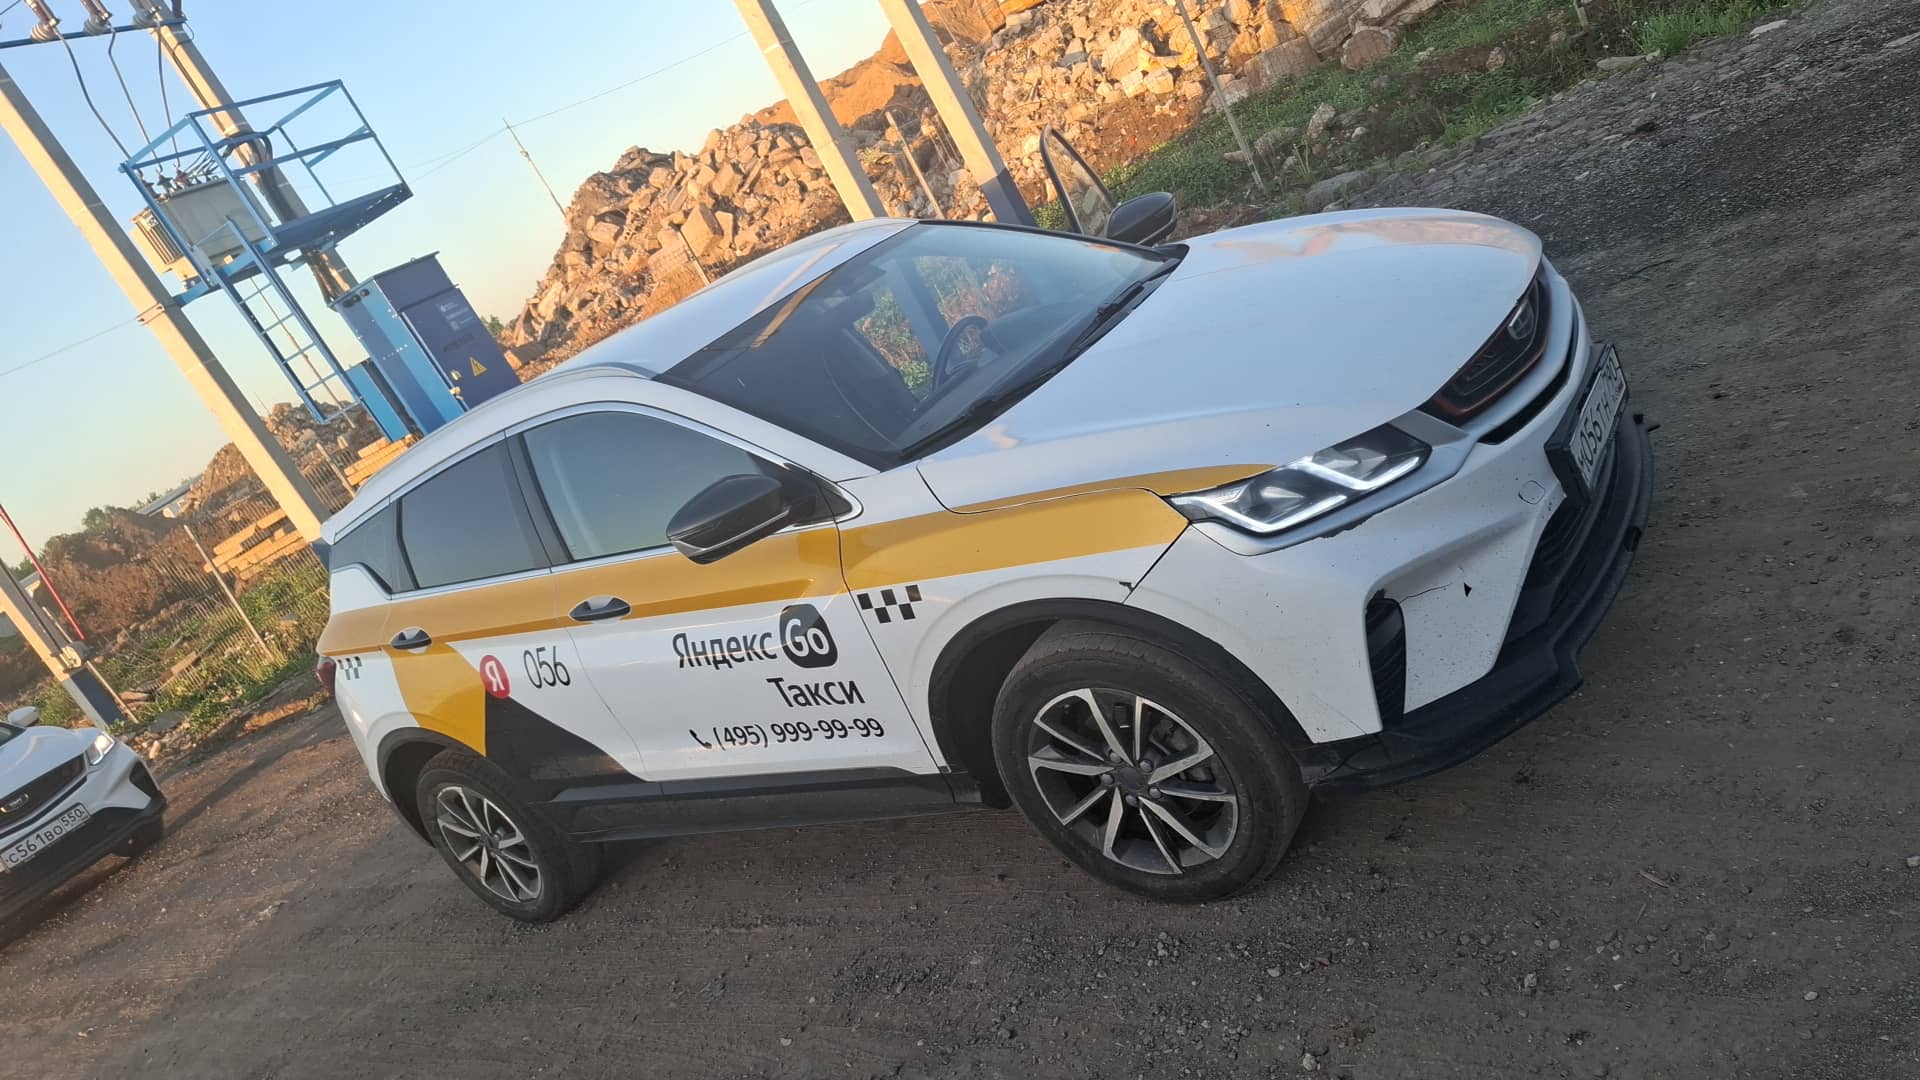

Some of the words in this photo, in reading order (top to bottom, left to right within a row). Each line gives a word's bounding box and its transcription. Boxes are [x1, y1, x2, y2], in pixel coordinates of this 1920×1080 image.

[672, 632, 778, 670] Яндекс
[785, 618, 830, 657] Go
[485, 660, 505, 692] Я
[523, 645, 571, 689] 056
[766, 677, 866, 707] Такси
[713, 724, 769, 750] (495)
[770, 717, 885, 743] 999-99-99
